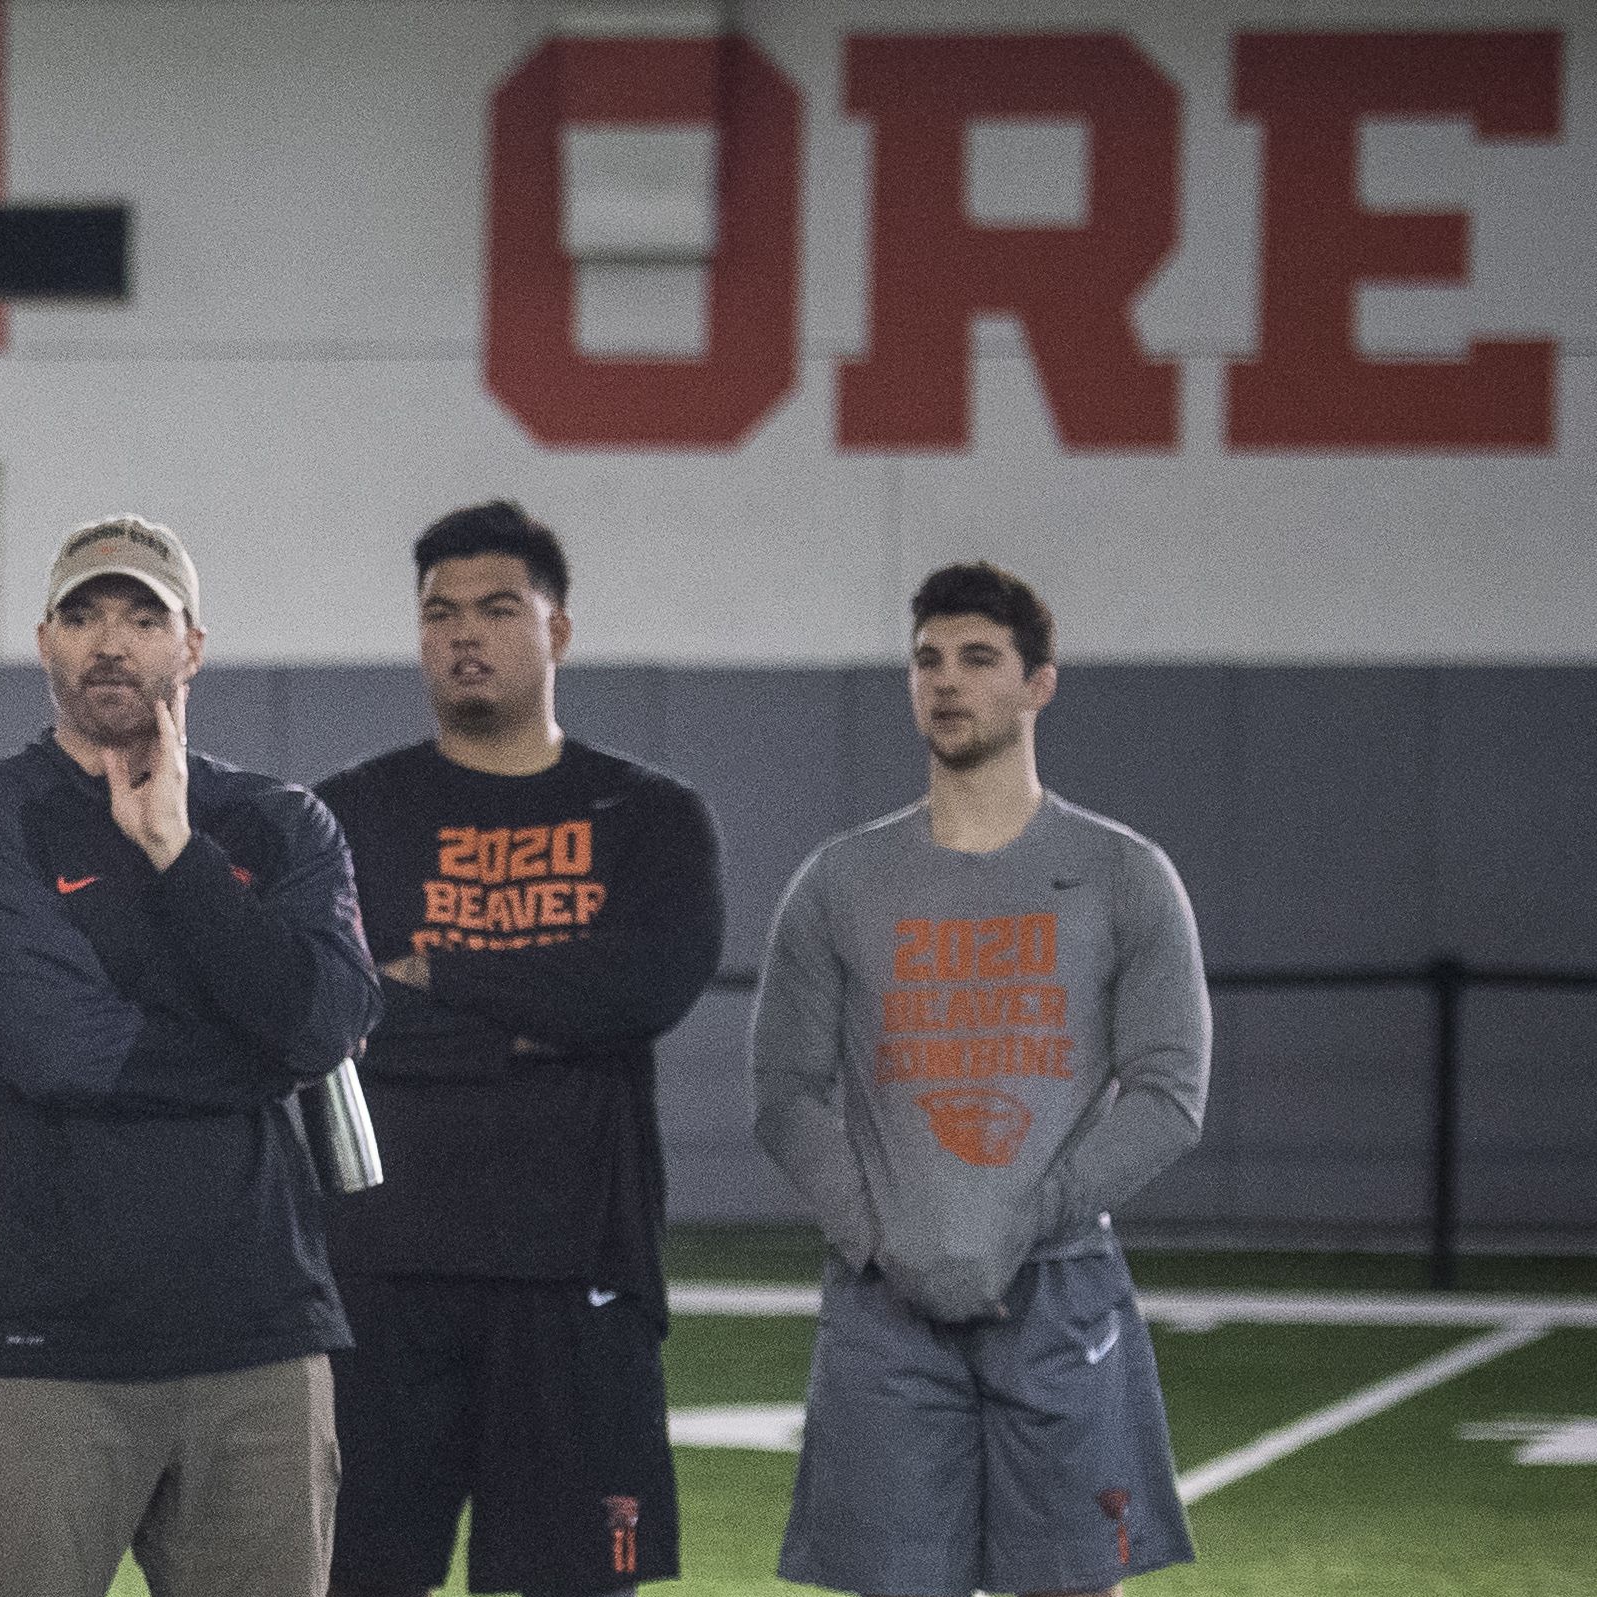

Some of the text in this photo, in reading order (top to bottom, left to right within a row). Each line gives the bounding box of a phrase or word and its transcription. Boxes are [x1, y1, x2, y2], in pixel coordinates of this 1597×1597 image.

[482, 32, 1563, 453] ORE
[437, 819, 593, 884] 2020
[422, 881, 607, 931] BEAVER
[893, 912, 1057, 981] 2020
[882, 984, 1068, 1033] BEAVER
[874, 1034, 1074, 1086] COMBINE
